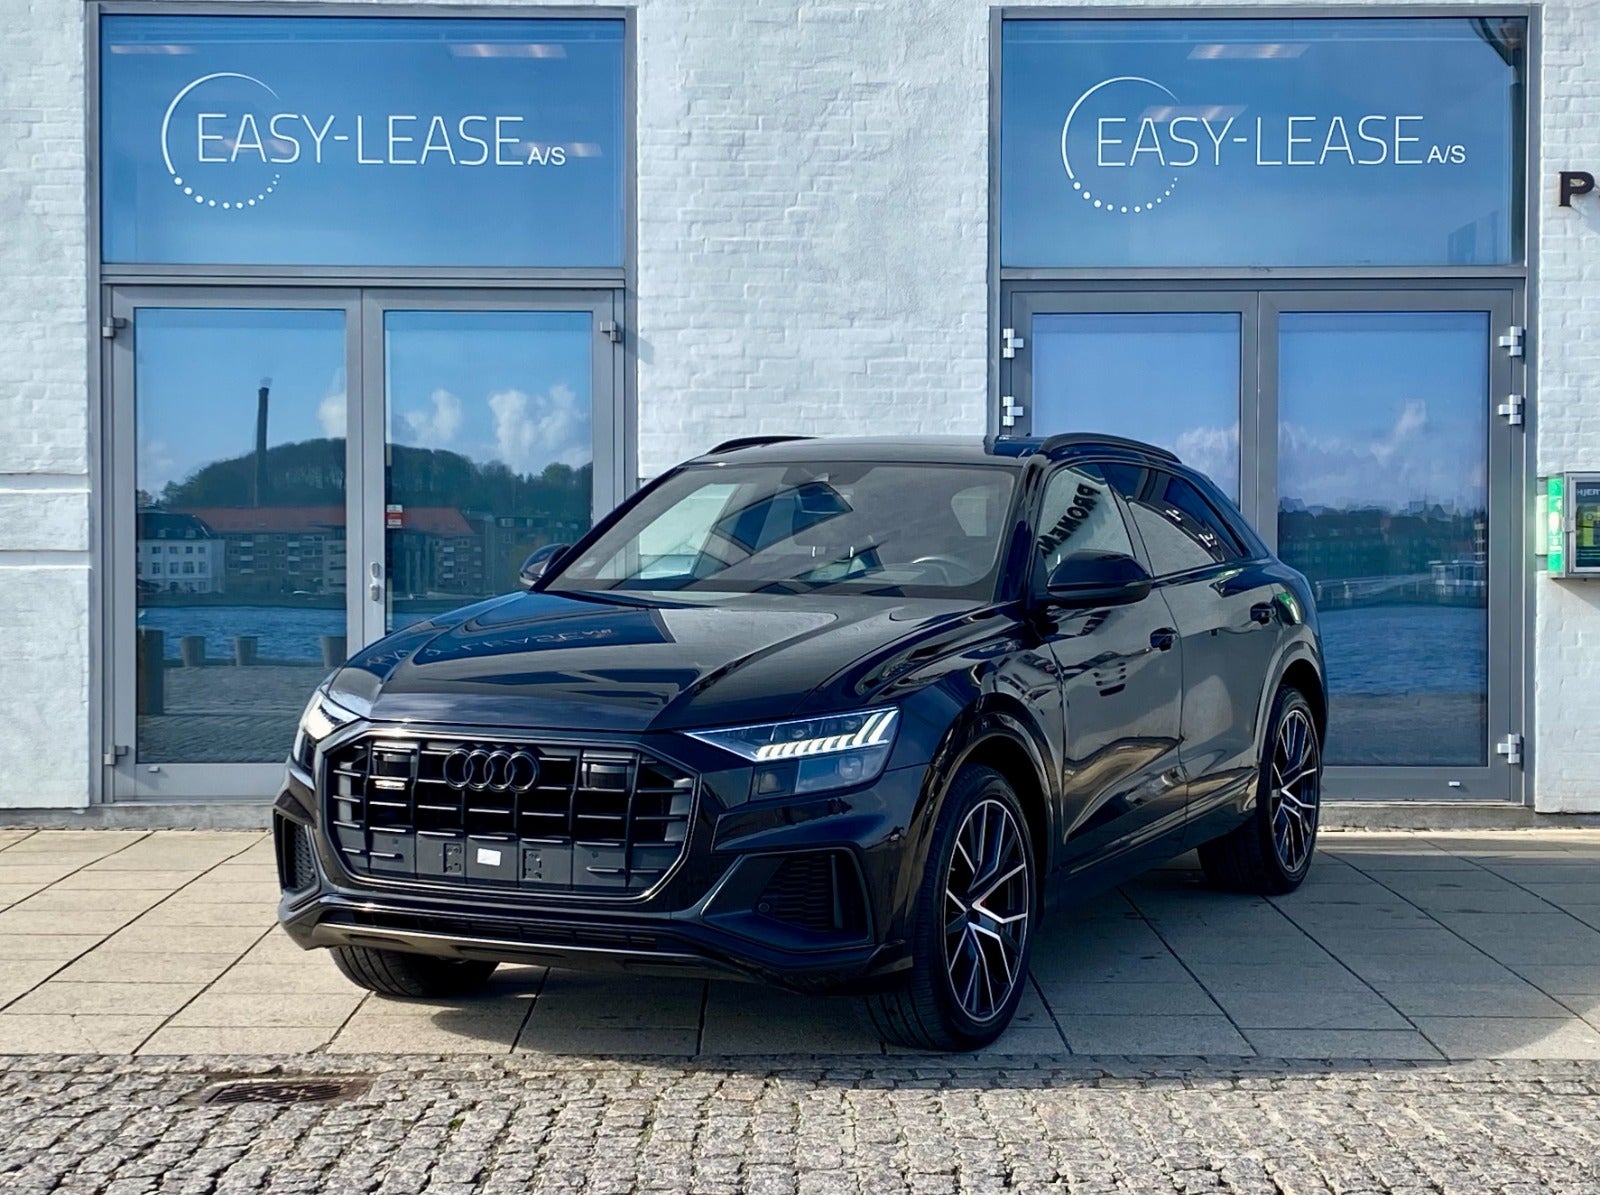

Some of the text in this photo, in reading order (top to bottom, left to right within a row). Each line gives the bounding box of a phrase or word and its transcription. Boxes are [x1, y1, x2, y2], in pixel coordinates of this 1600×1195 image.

[197, 112, 567, 167] EASY-LEASE A/S
[1097, 115, 1467, 167] EASY-LEASE A/S
[1576, 488, 1600, 497] HJER
